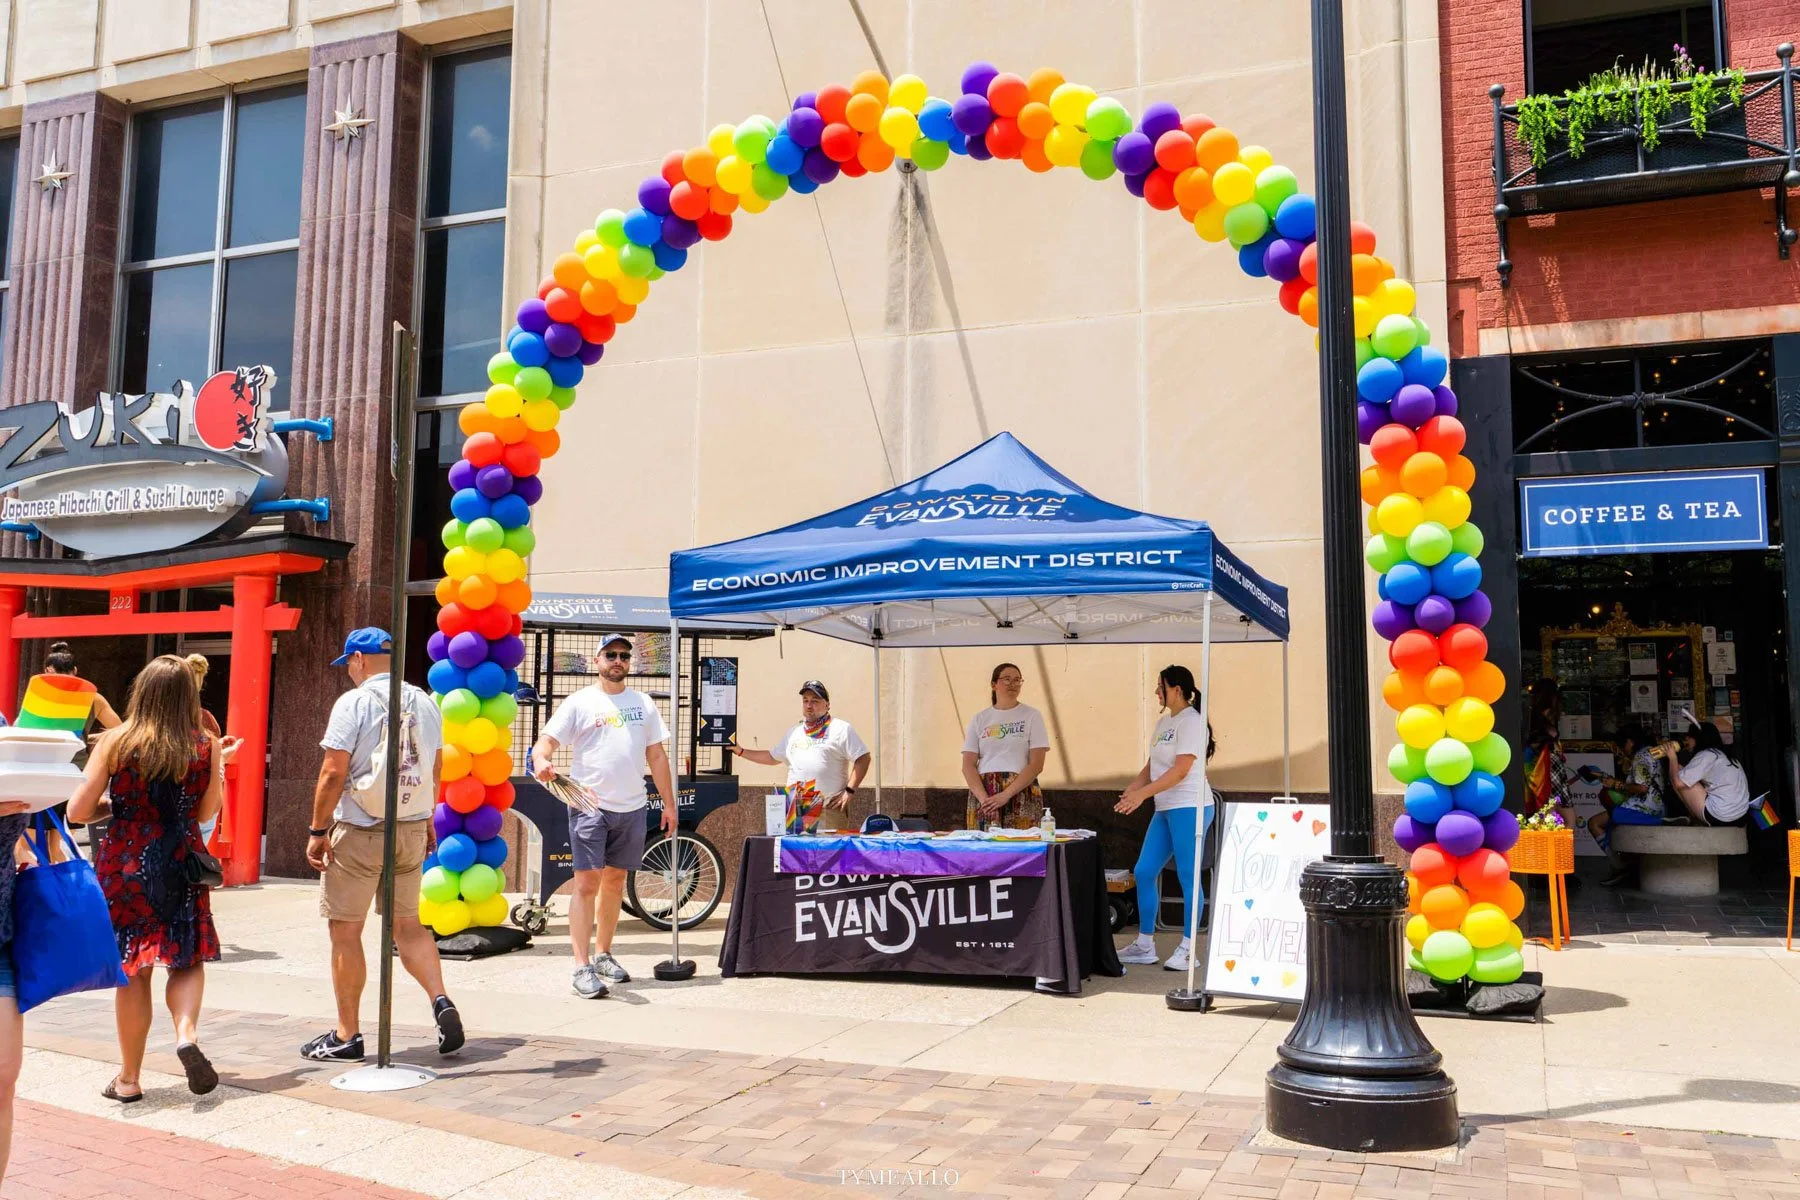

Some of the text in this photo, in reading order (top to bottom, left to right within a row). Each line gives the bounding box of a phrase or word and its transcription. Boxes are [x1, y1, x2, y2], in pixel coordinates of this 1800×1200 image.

[2, 486, 224, 521] Japanese Hibachi Grill & Sushi Lounge
[856, 500, 1062, 526] EVANSVILLE
[871, 494, 1067, 512] DOWNTOWN
[1544, 501, 1742, 525] COFFEE & TEA
[692, 550, 1182, 591] ECONOMIC IMPROVEMENT DISTRICT
[1215, 554, 1286, 618] ECONOMIC IMPROVEMENT DISTRICT
[111, 596, 131, 610] 222
[795, 877, 1014, 954] EVANSVILLE
